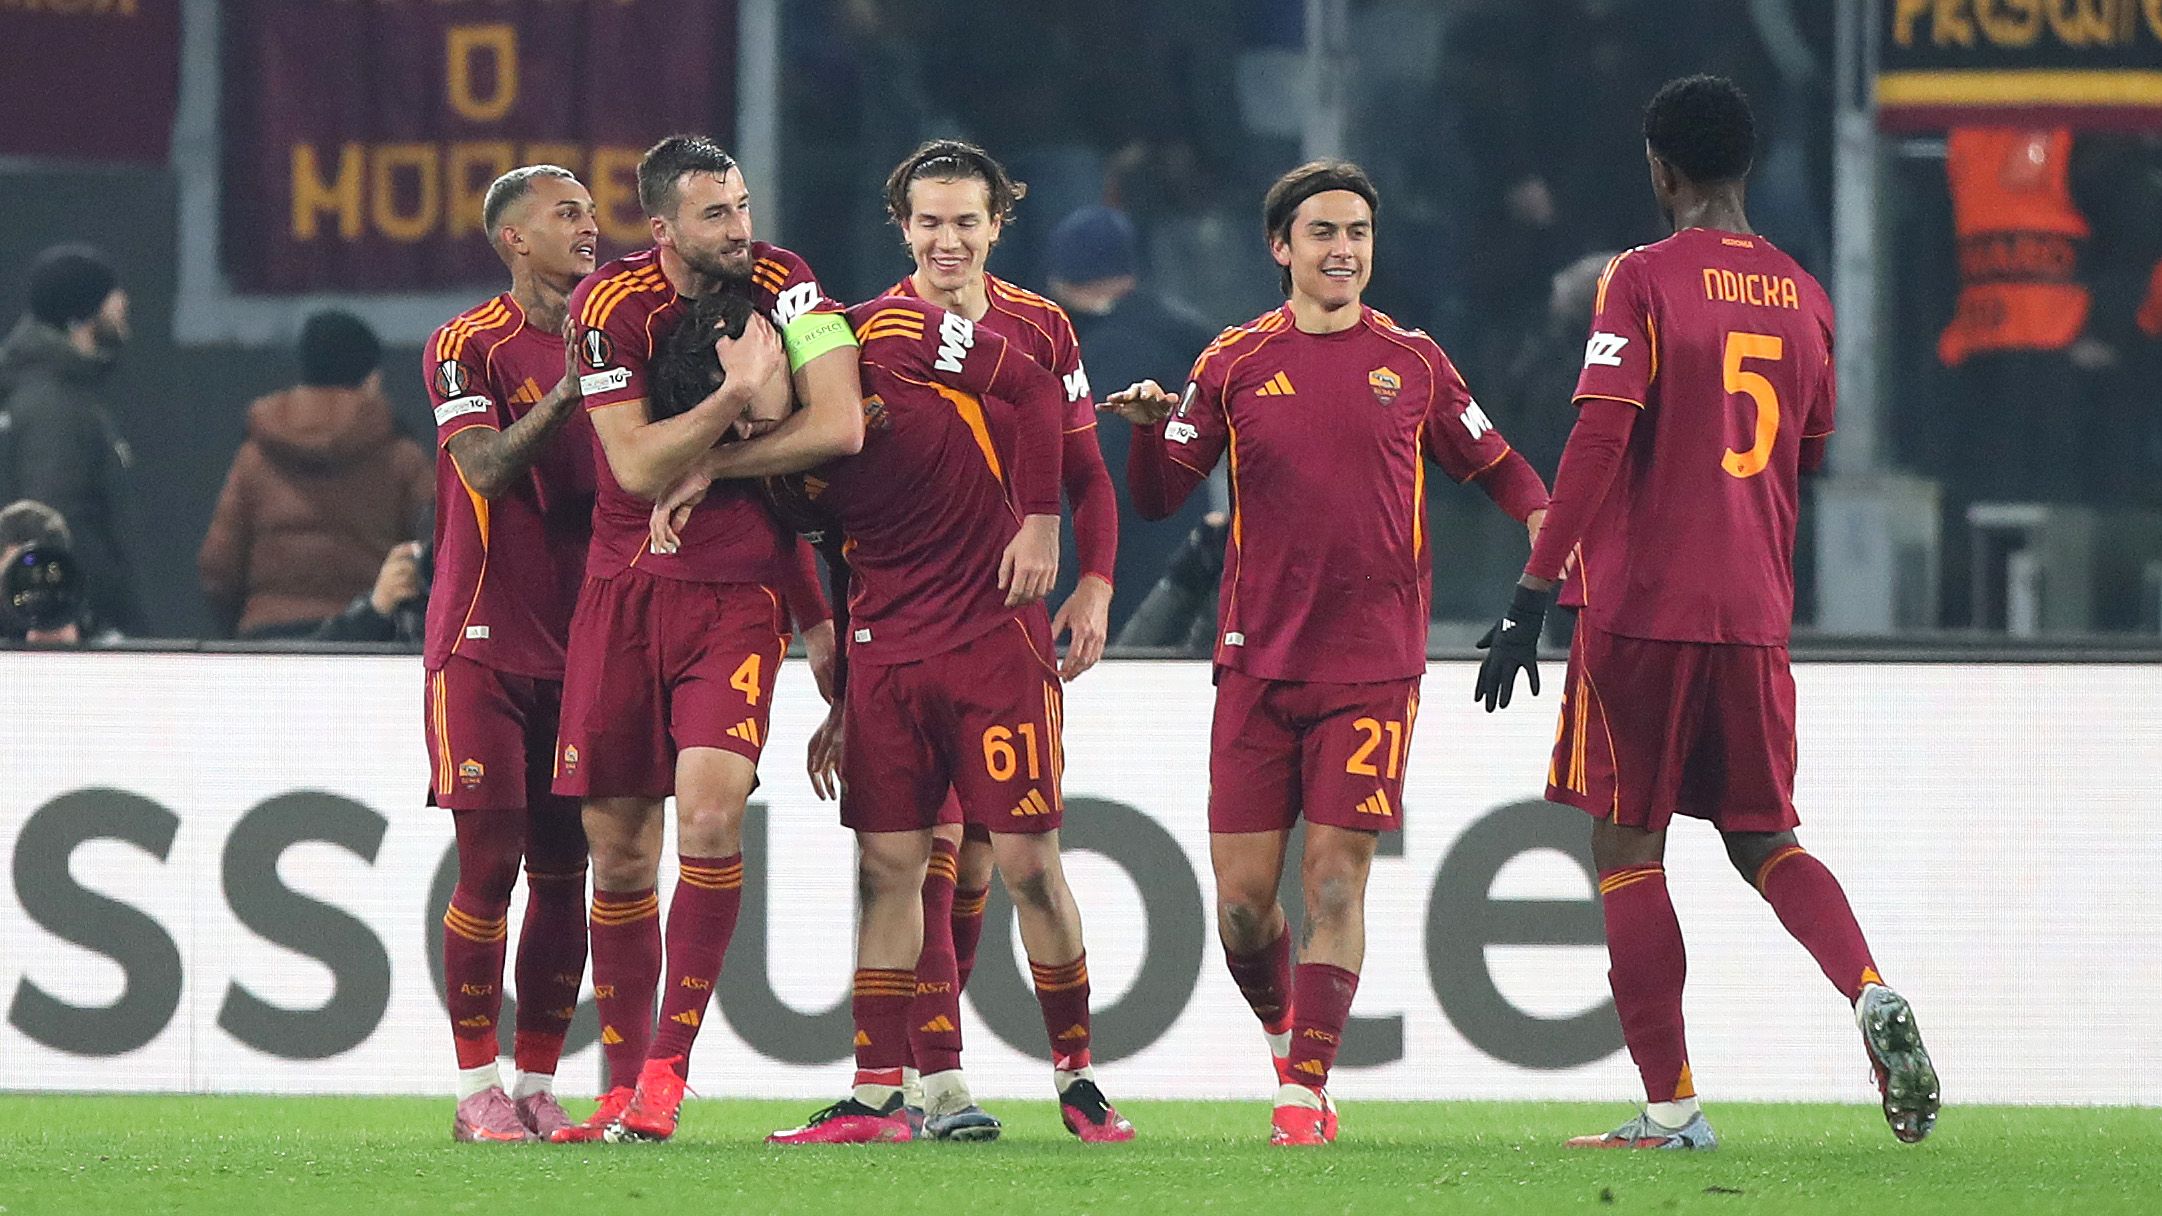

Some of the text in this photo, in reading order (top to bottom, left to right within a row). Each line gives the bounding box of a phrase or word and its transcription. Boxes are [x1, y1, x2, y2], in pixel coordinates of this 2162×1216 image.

[293, 141, 647, 243] MORE
[1703, 268, 1799, 310] NDICKA
[804, 321, 843, 342] RESPECT
[1721, 331, 1783, 479] 5
[729, 653, 761, 706] 4
[982, 722, 1040, 781] 61
[1346, 717, 1402, 780] 21
[916, 982, 950, 995] ASR
